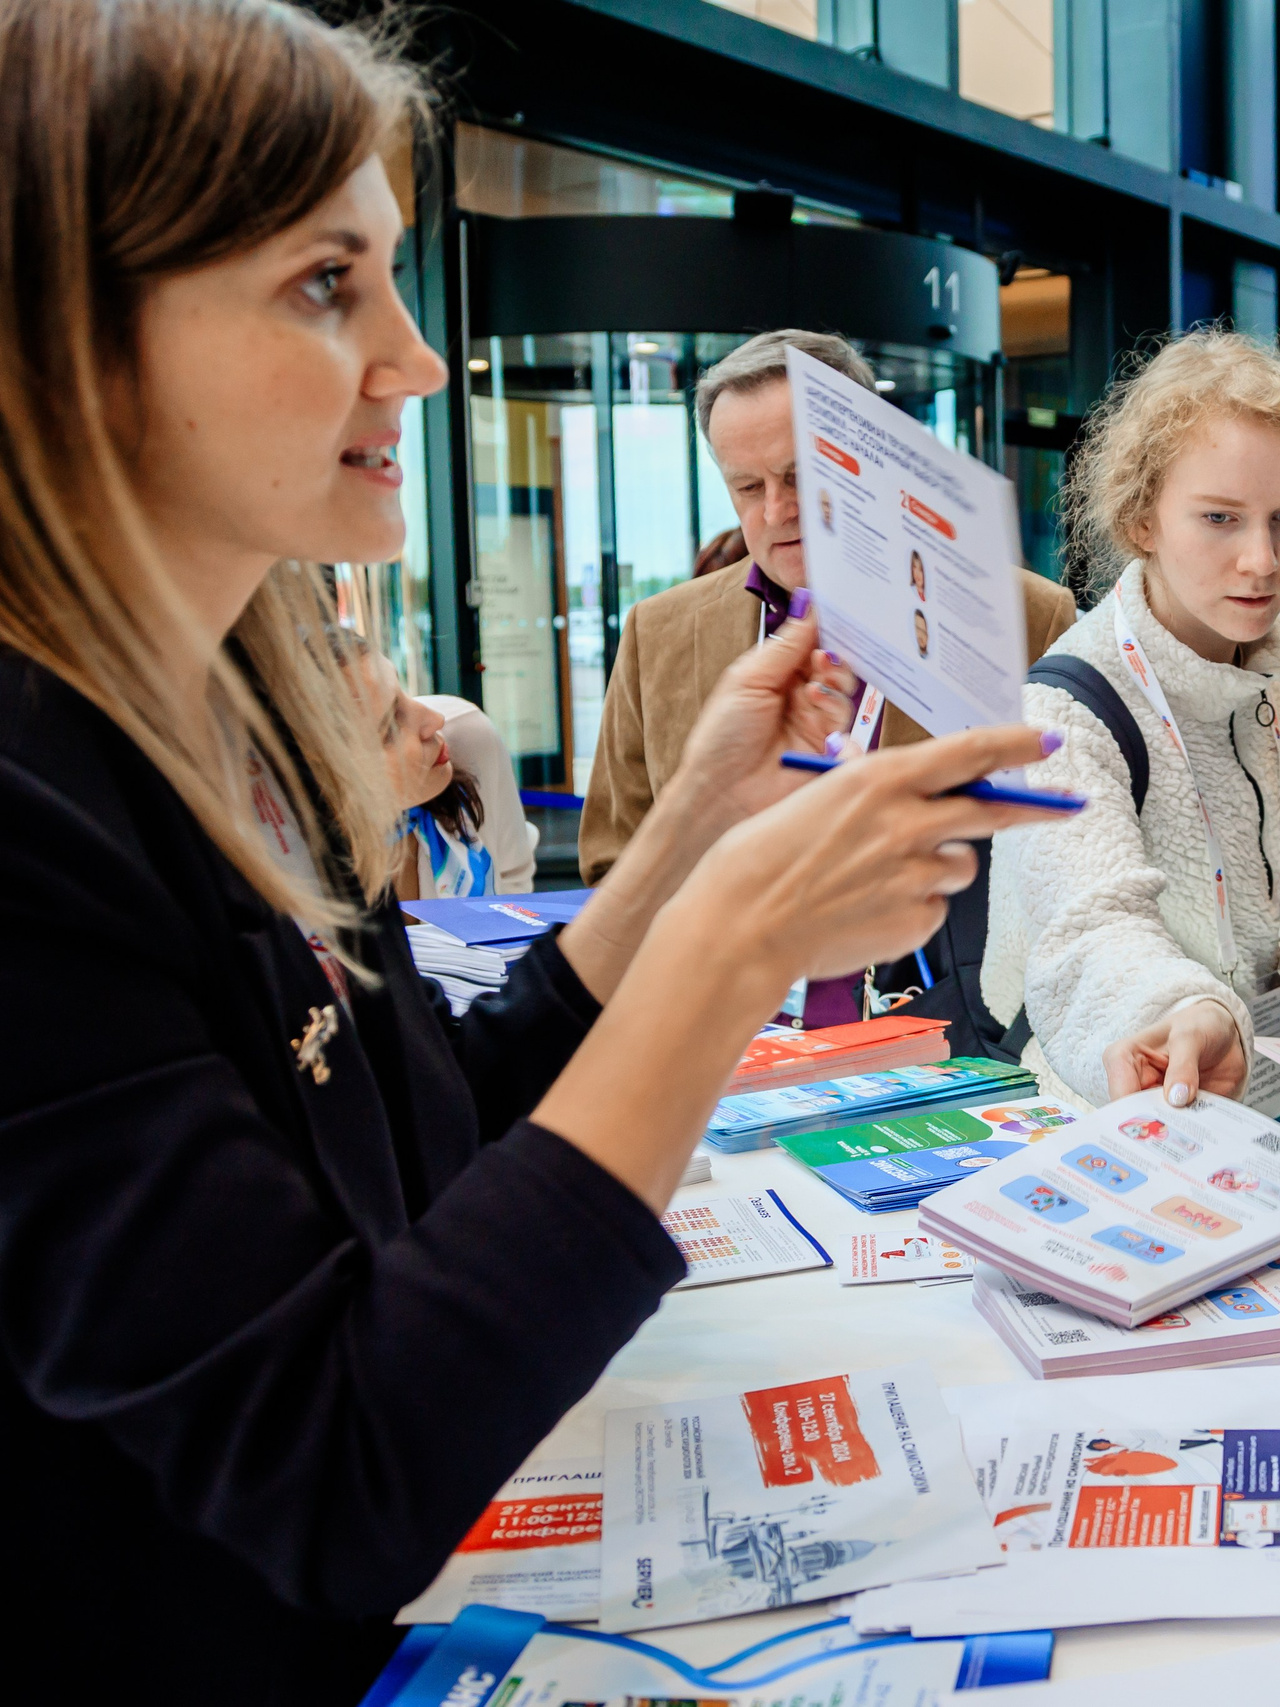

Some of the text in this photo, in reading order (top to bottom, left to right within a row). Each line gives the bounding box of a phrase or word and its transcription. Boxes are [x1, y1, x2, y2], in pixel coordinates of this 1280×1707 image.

[923, 266, 960, 313] 11
[750, 1196, 771, 1218] SERVIER
[773, 1400, 803, 1477] Конференц-зал 2
[819, 1392, 852, 1464] 27 сентября 2024
[882, 1382, 931, 1496] ПРИГЛАШЕНИЕ НА СИМПОЗИУМ
[513, 1472, 603, 1484] ПРИГЛАШ
[1048, 1432, 1087, 1547] Приглашение на симпозиум
[491, 1524, 601, 1540] Конфере
[498, 1512, 602, 1527] 11:00–12:3
[499, 1504, 527, 1516] 27
[632, 1558, 653, 1608] SERVIER
